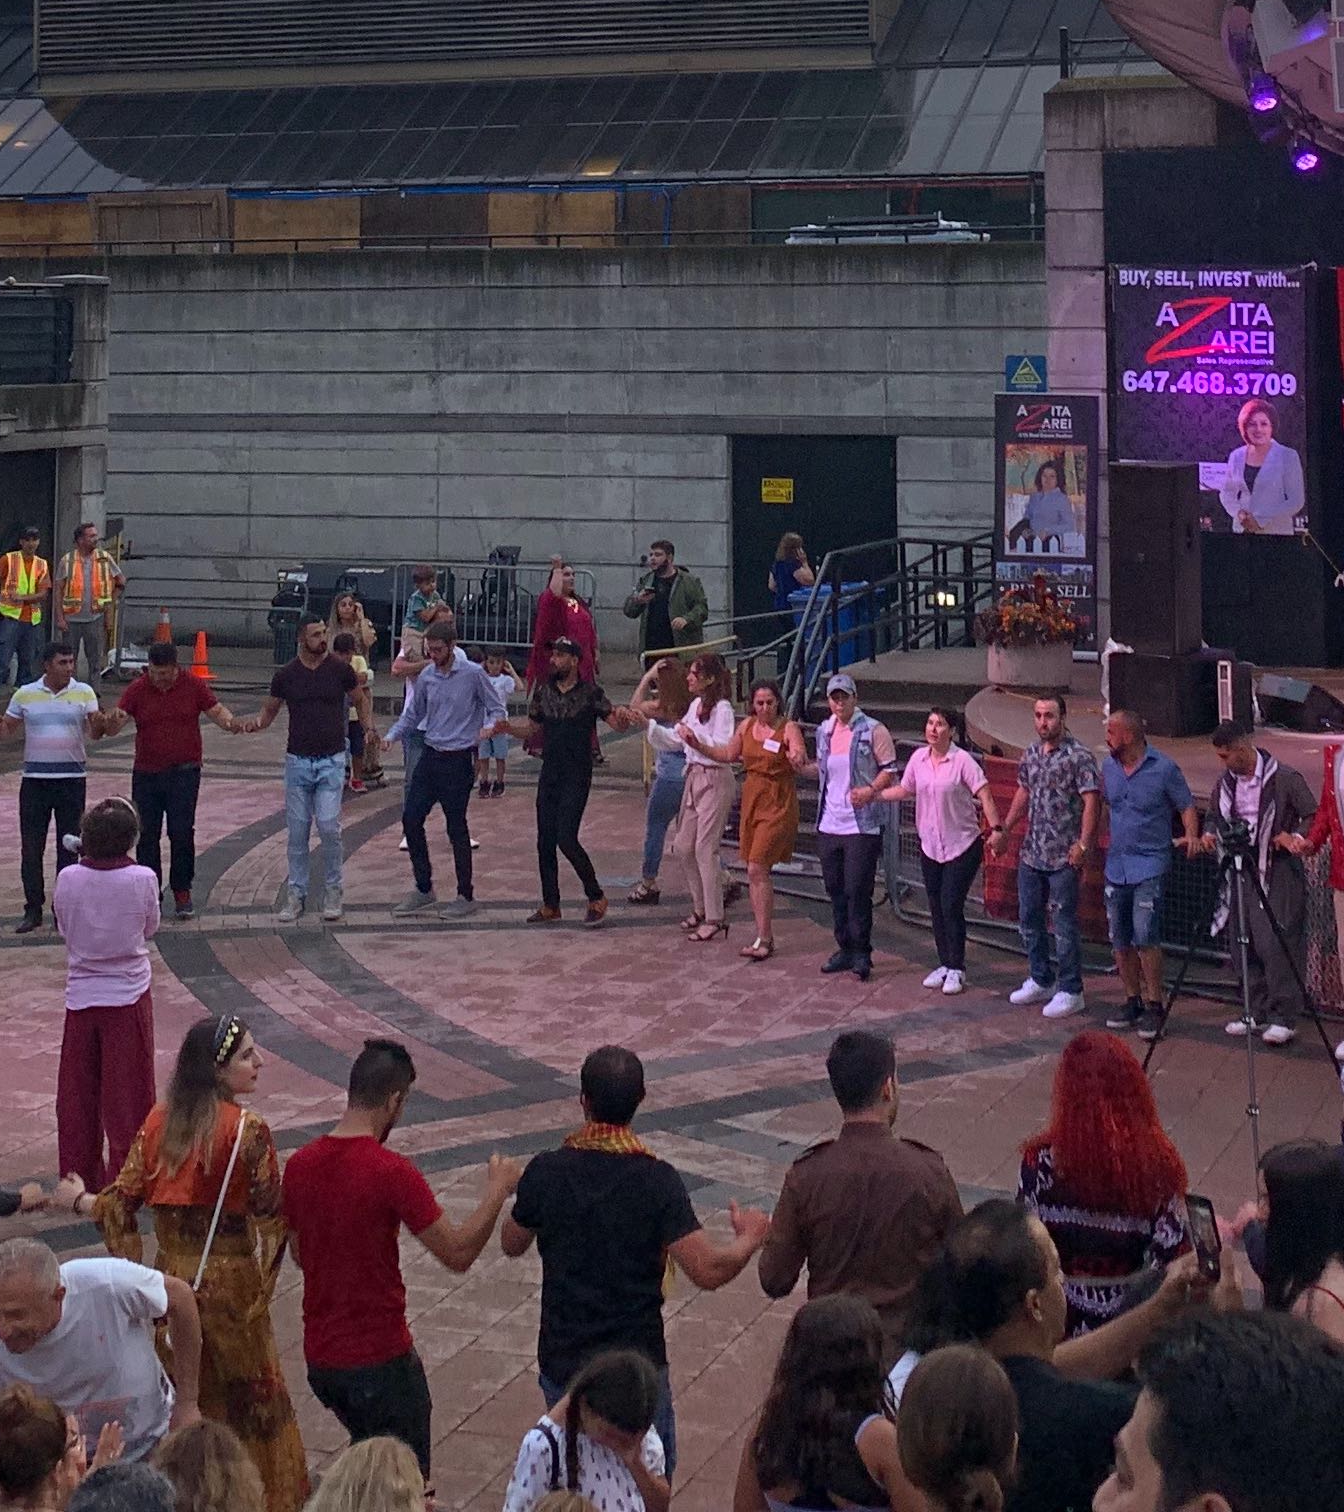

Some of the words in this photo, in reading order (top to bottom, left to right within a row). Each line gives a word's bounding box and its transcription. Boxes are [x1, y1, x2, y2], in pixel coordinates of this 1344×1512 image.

[1119, 270, 1151, 289] BUY,
[1155, 271, 1195, 290] SELL,
[1198, 271, 1252, 288] INVEST
[1122, 369, 1297, 396] 647.468.3709
[1056, 584, 1091, 598] SELL
